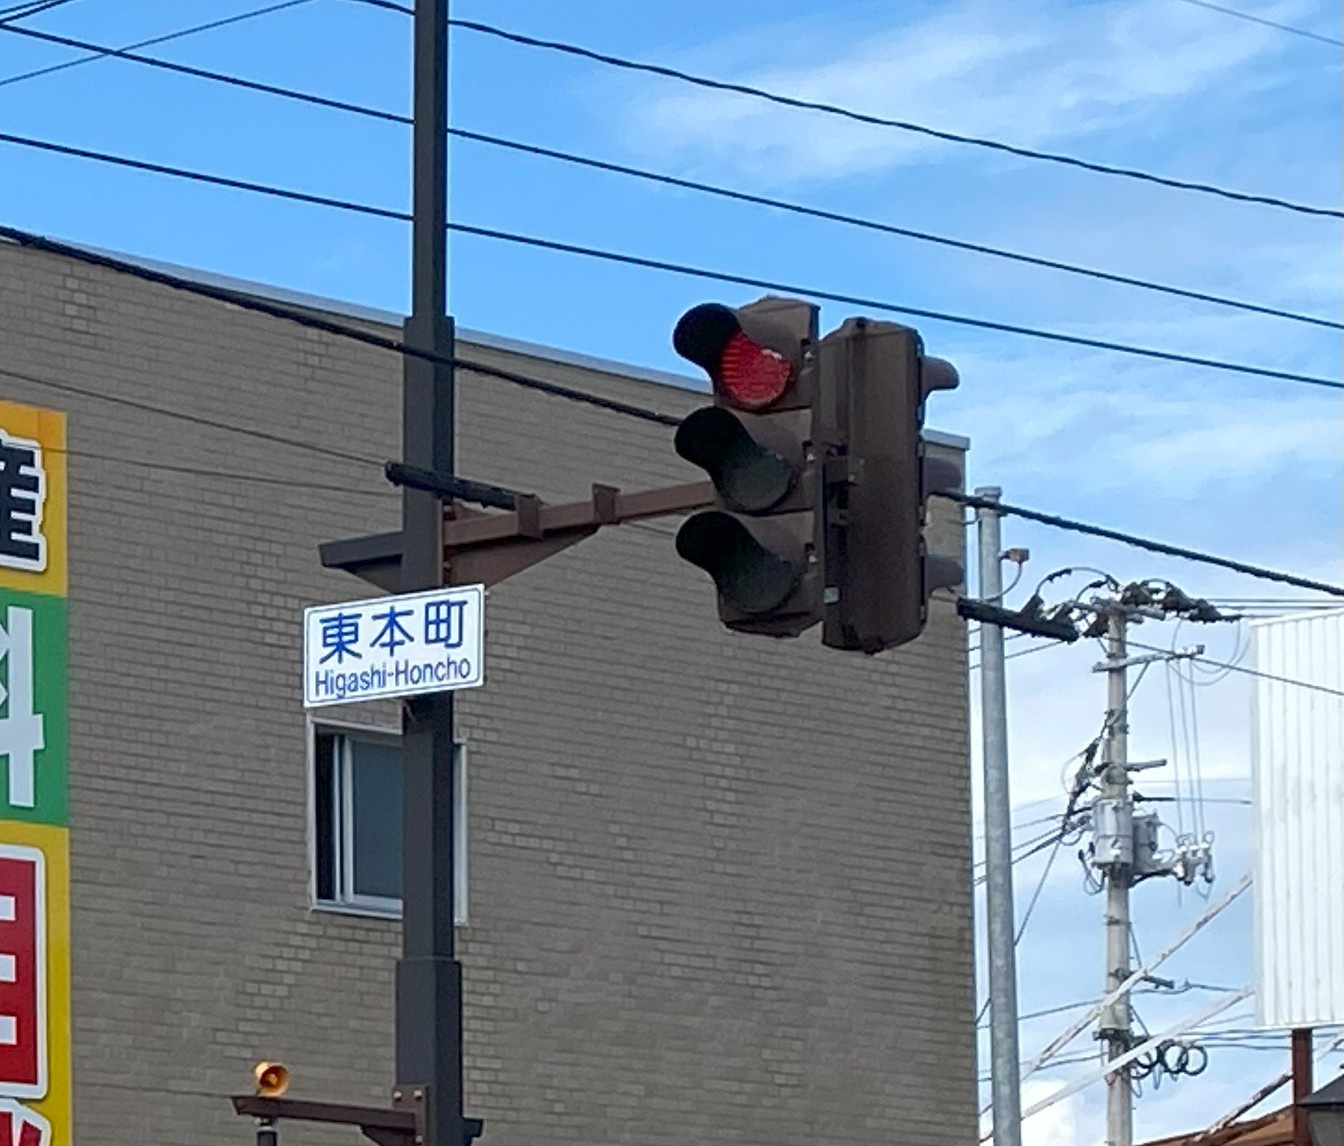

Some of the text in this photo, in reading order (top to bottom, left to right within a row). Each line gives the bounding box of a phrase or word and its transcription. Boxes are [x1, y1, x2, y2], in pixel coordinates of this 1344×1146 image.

[319, 600, 468, 664] 東本町
[315, 653, 471, 698] Higashi-Honcho
